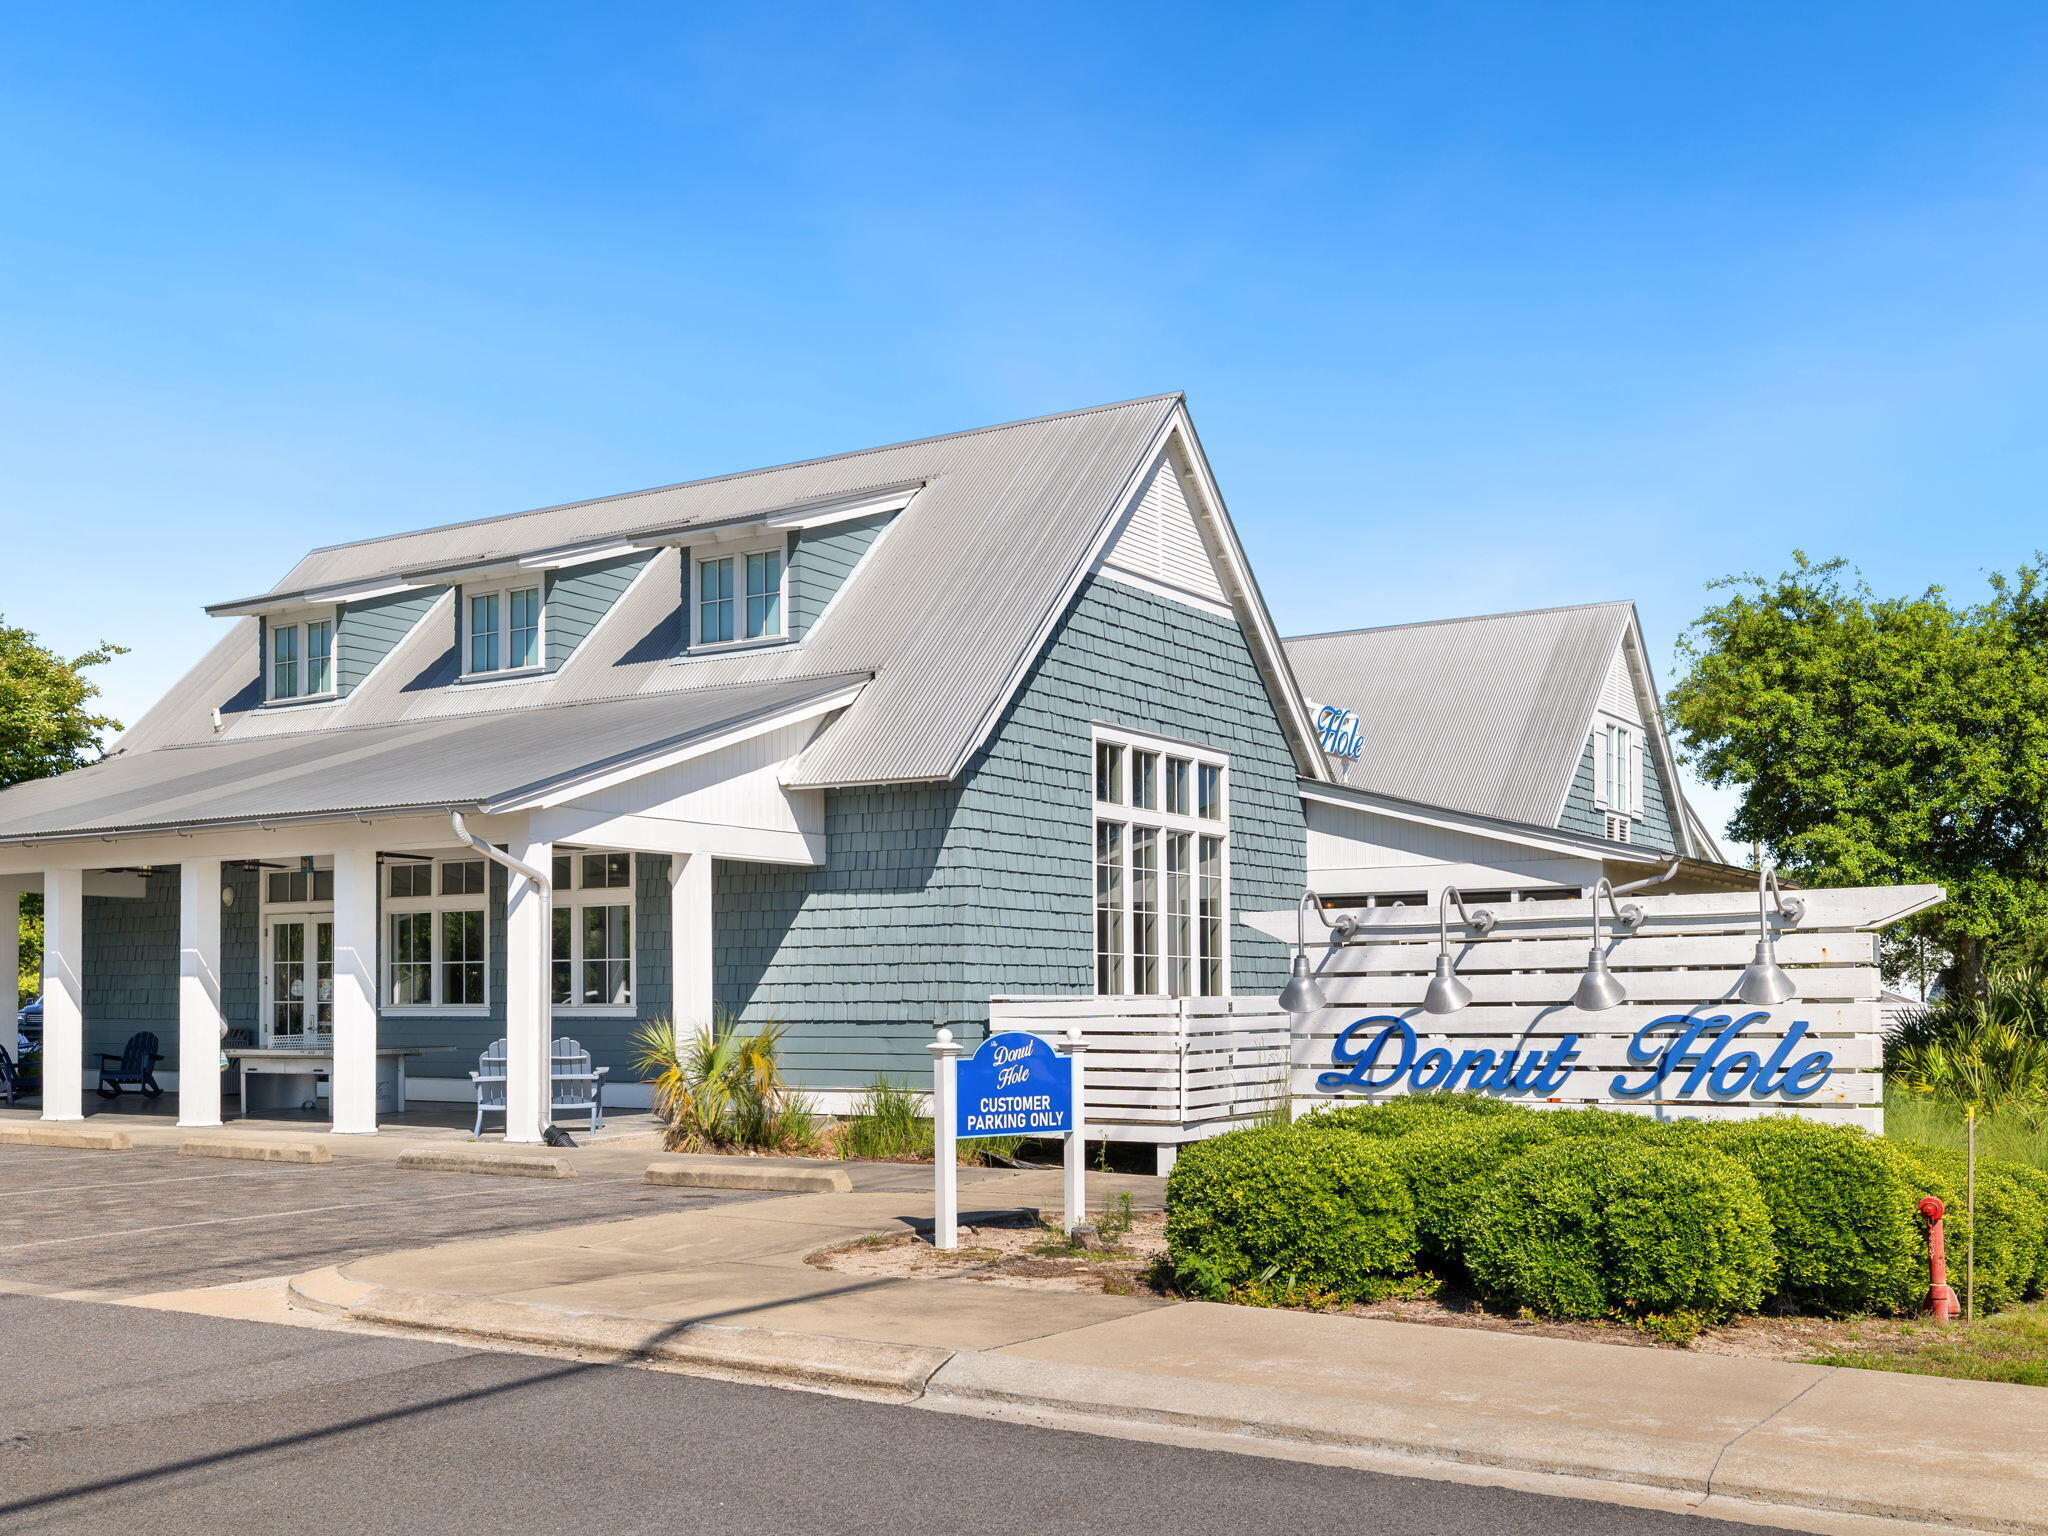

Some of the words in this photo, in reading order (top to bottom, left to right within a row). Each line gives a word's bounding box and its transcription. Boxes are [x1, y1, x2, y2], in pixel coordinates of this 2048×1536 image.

[1318, 705, 1364, 758] Hole
[992, 1039, 1034, 1067] Donut
[1318, 1015, 1582, 1092] Donut
[1612, 1011, 1834, 1095] Hole
[996, 1064, 1030, 1090] Hole
[980, 1095, 1051, 1113] CUSTOMER
[967, 1114, 1026, 1131] PARKING
[1030, 1111, 1064, 1128] ONLY
